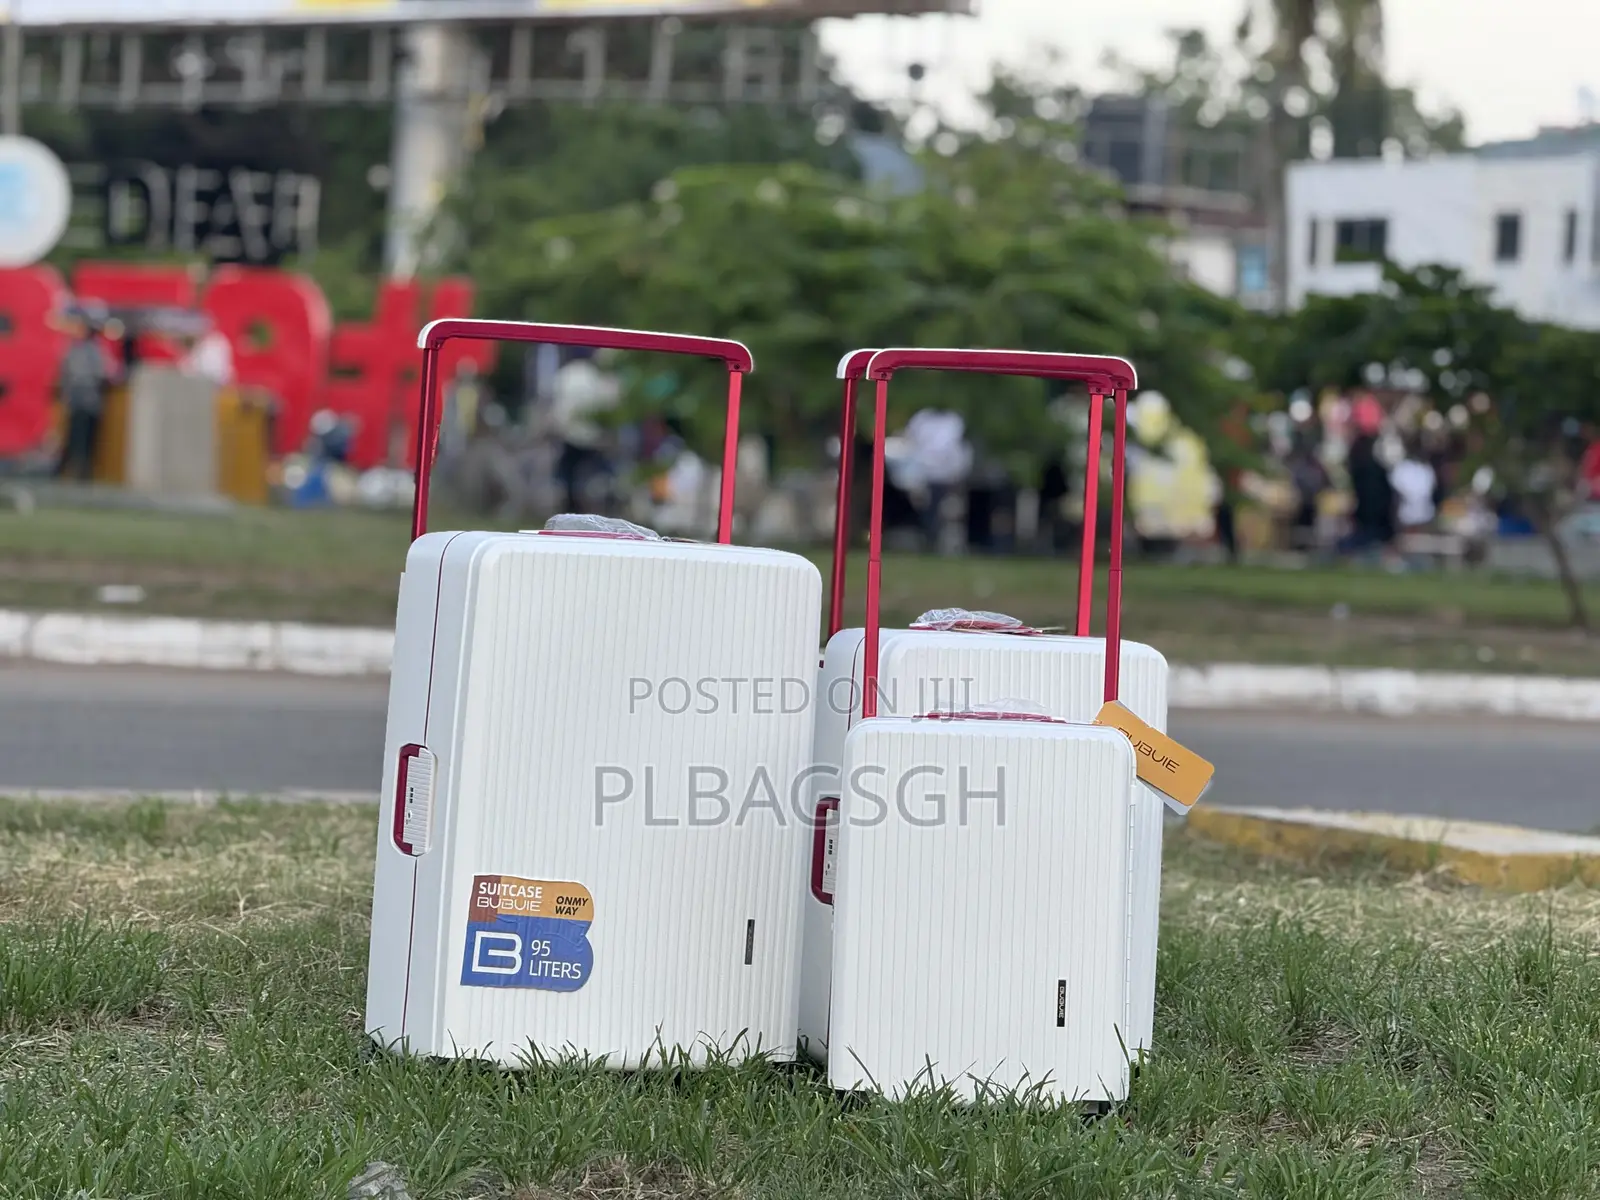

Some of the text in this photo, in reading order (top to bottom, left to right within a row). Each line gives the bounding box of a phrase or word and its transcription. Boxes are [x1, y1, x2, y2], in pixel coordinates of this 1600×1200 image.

[478, 882, 542, 898] SUITCASE
[476, 896, 541, 911] BUBUIE
[555, 905, 579, 916] WAY
[531, 939, 551, 957] 95
[529, 959, 582, 980] LITERS
